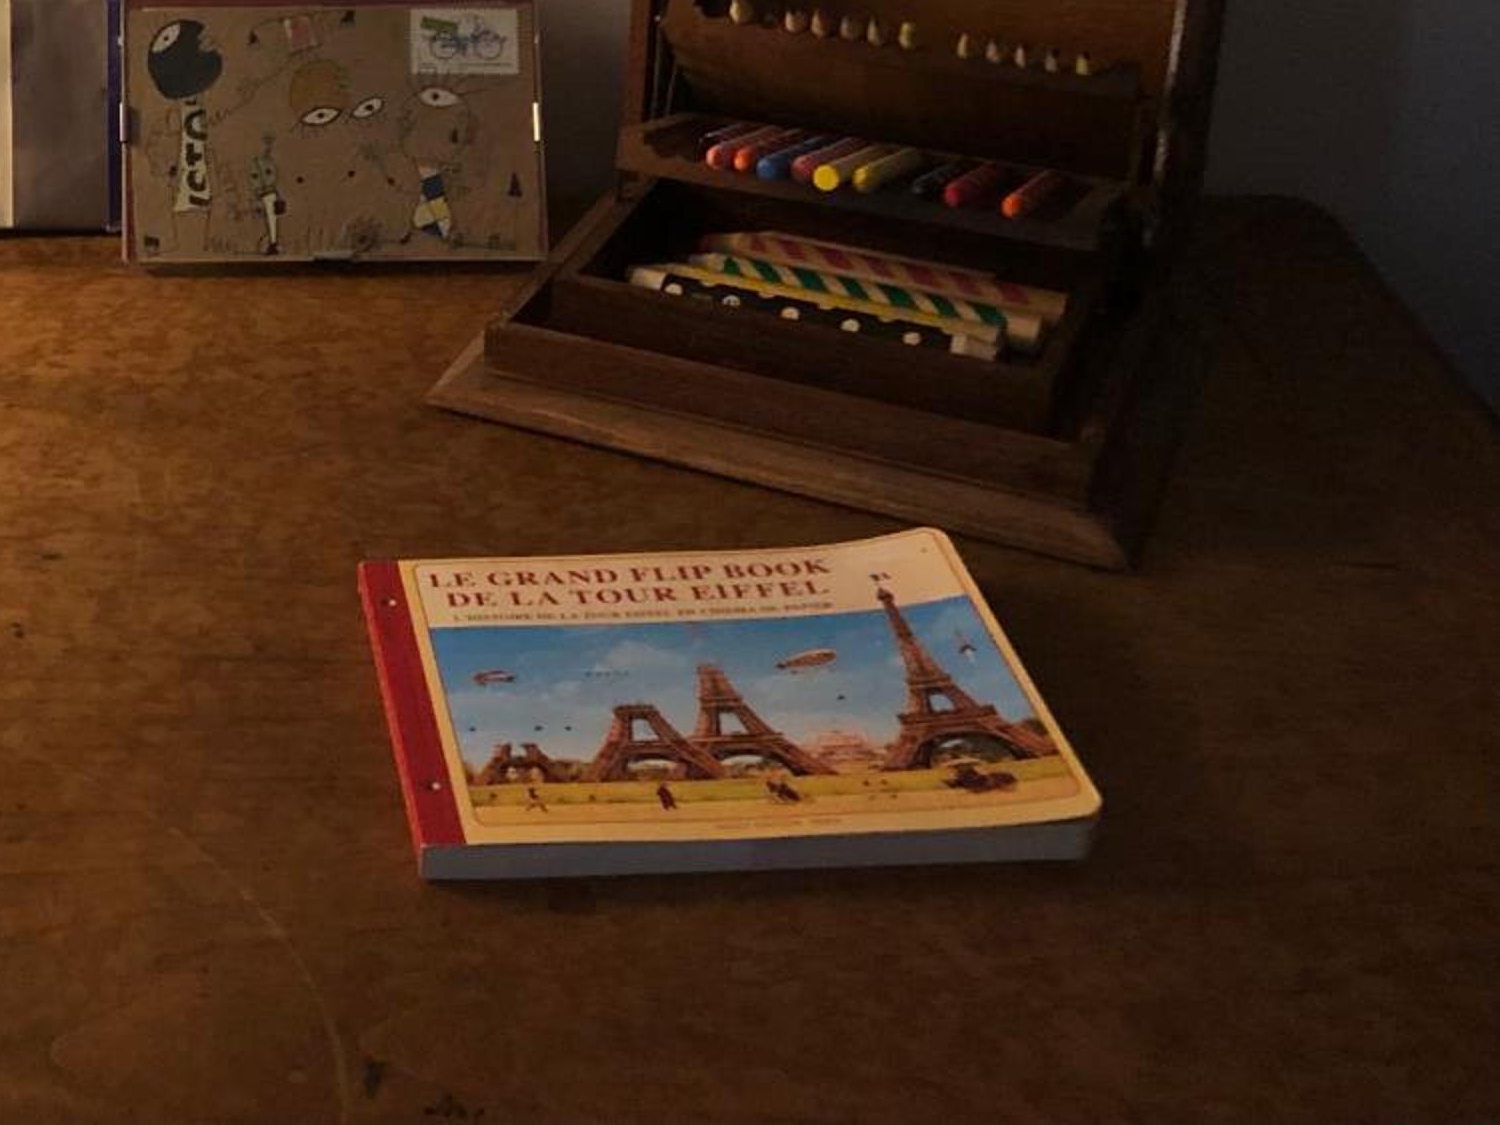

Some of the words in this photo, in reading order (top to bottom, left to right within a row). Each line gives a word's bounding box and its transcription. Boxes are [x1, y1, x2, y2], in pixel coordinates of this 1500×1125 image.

[429, 573, 477, 588] LE
[487, 569, 618, 586] GRAND
[630, 566, 711, 582] FLIP
[723, 559, 831, 579] BOOK
[447, 592, 498, 607] DE
[509, 590, 560, 606] LA
[568, 585, 677, 604] TOUR
[692, 580, 830, 601] EIFFEL
